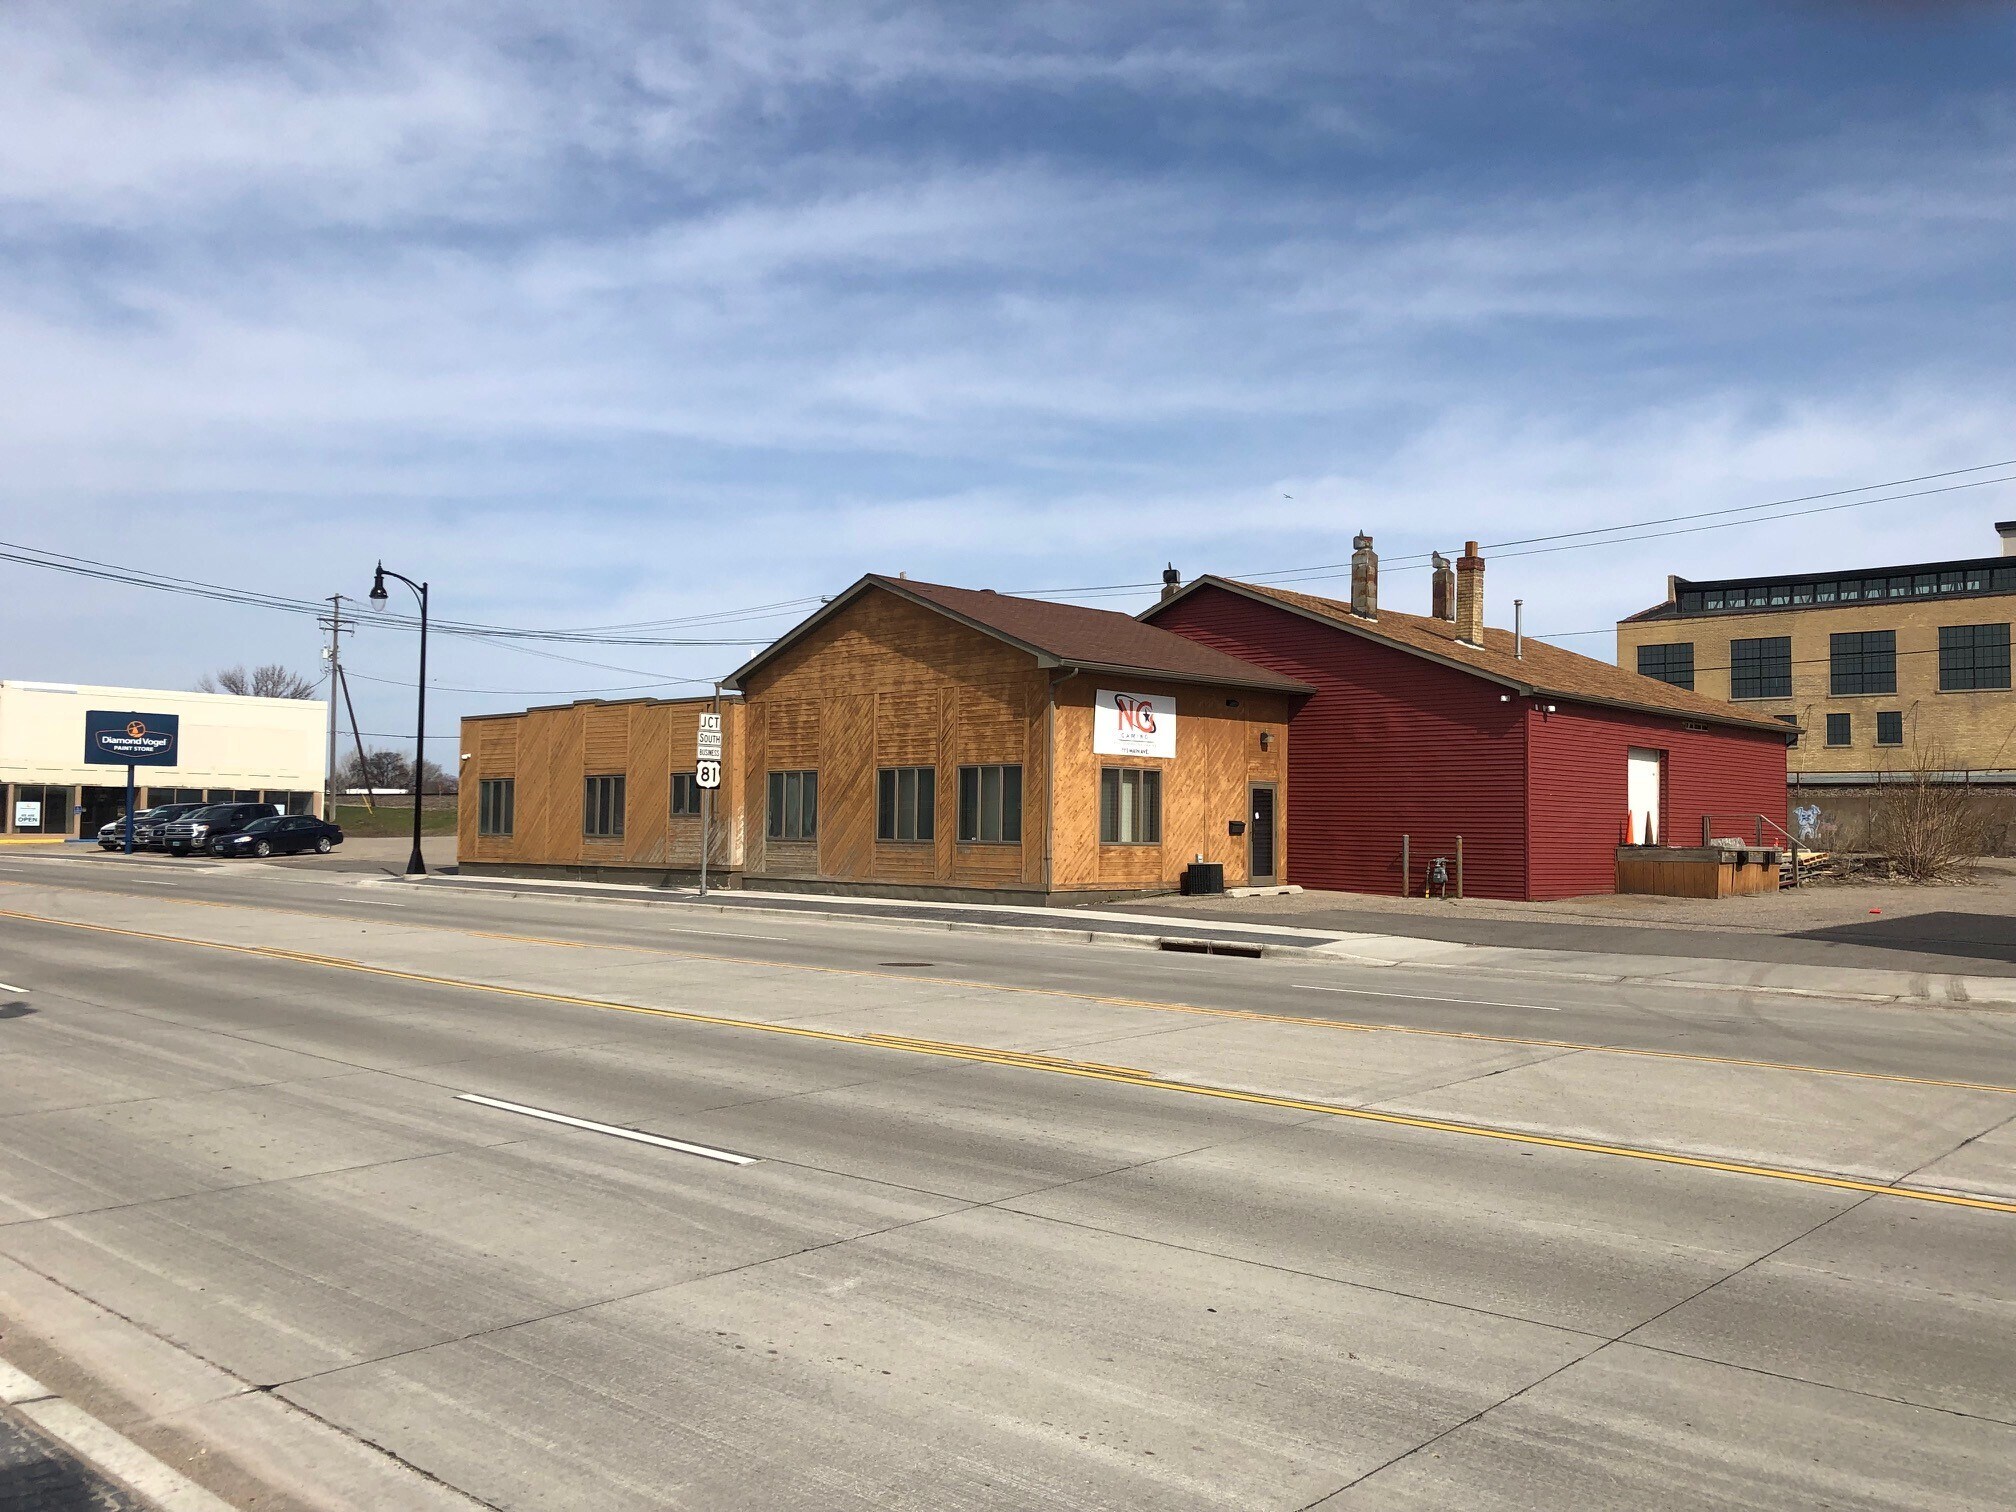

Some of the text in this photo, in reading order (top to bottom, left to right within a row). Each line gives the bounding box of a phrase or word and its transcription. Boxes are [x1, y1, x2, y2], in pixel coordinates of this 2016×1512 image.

[701, 716, 719, 728] JCT
[102, 736, 166, 747] Diamond Vogel
[700, 733, 720, 743] SOUTH
[699, 748, 720, 756] BUSINESS
[701, 766, 716, 782] 81
